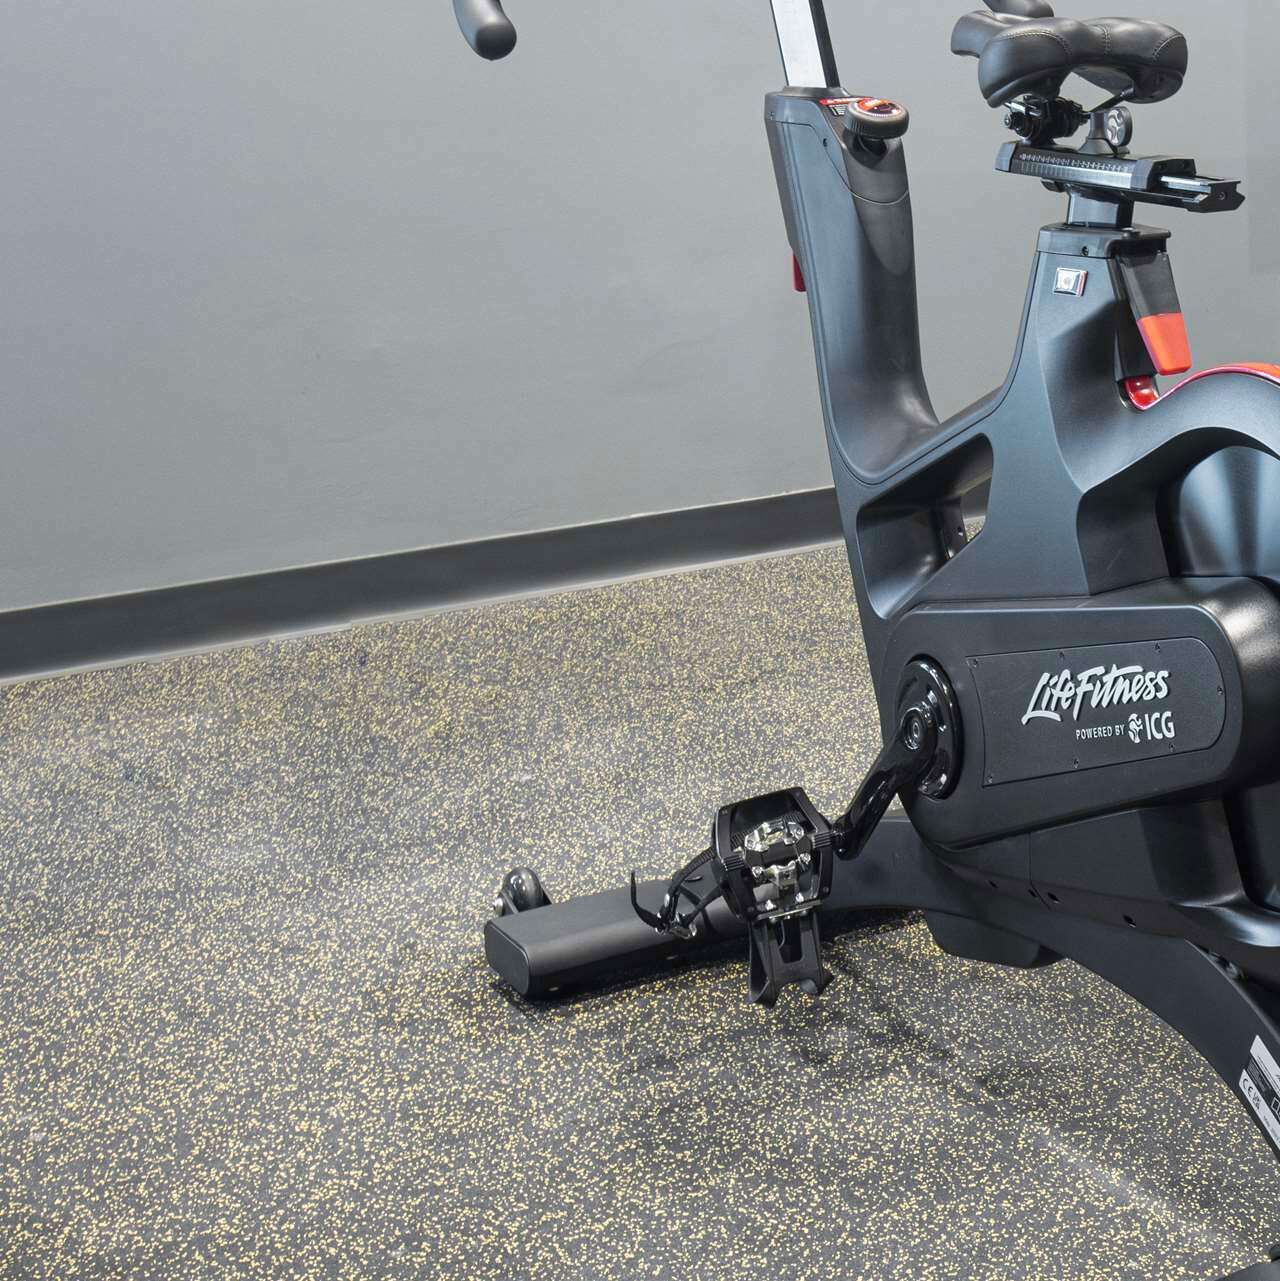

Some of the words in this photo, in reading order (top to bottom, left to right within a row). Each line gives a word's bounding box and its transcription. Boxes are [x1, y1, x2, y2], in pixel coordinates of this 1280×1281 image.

[1076, 725, 1113, 740] POWERED
[1115, 724, 1125, 736] BY
[1144, 711, 1175, 740] ICG
